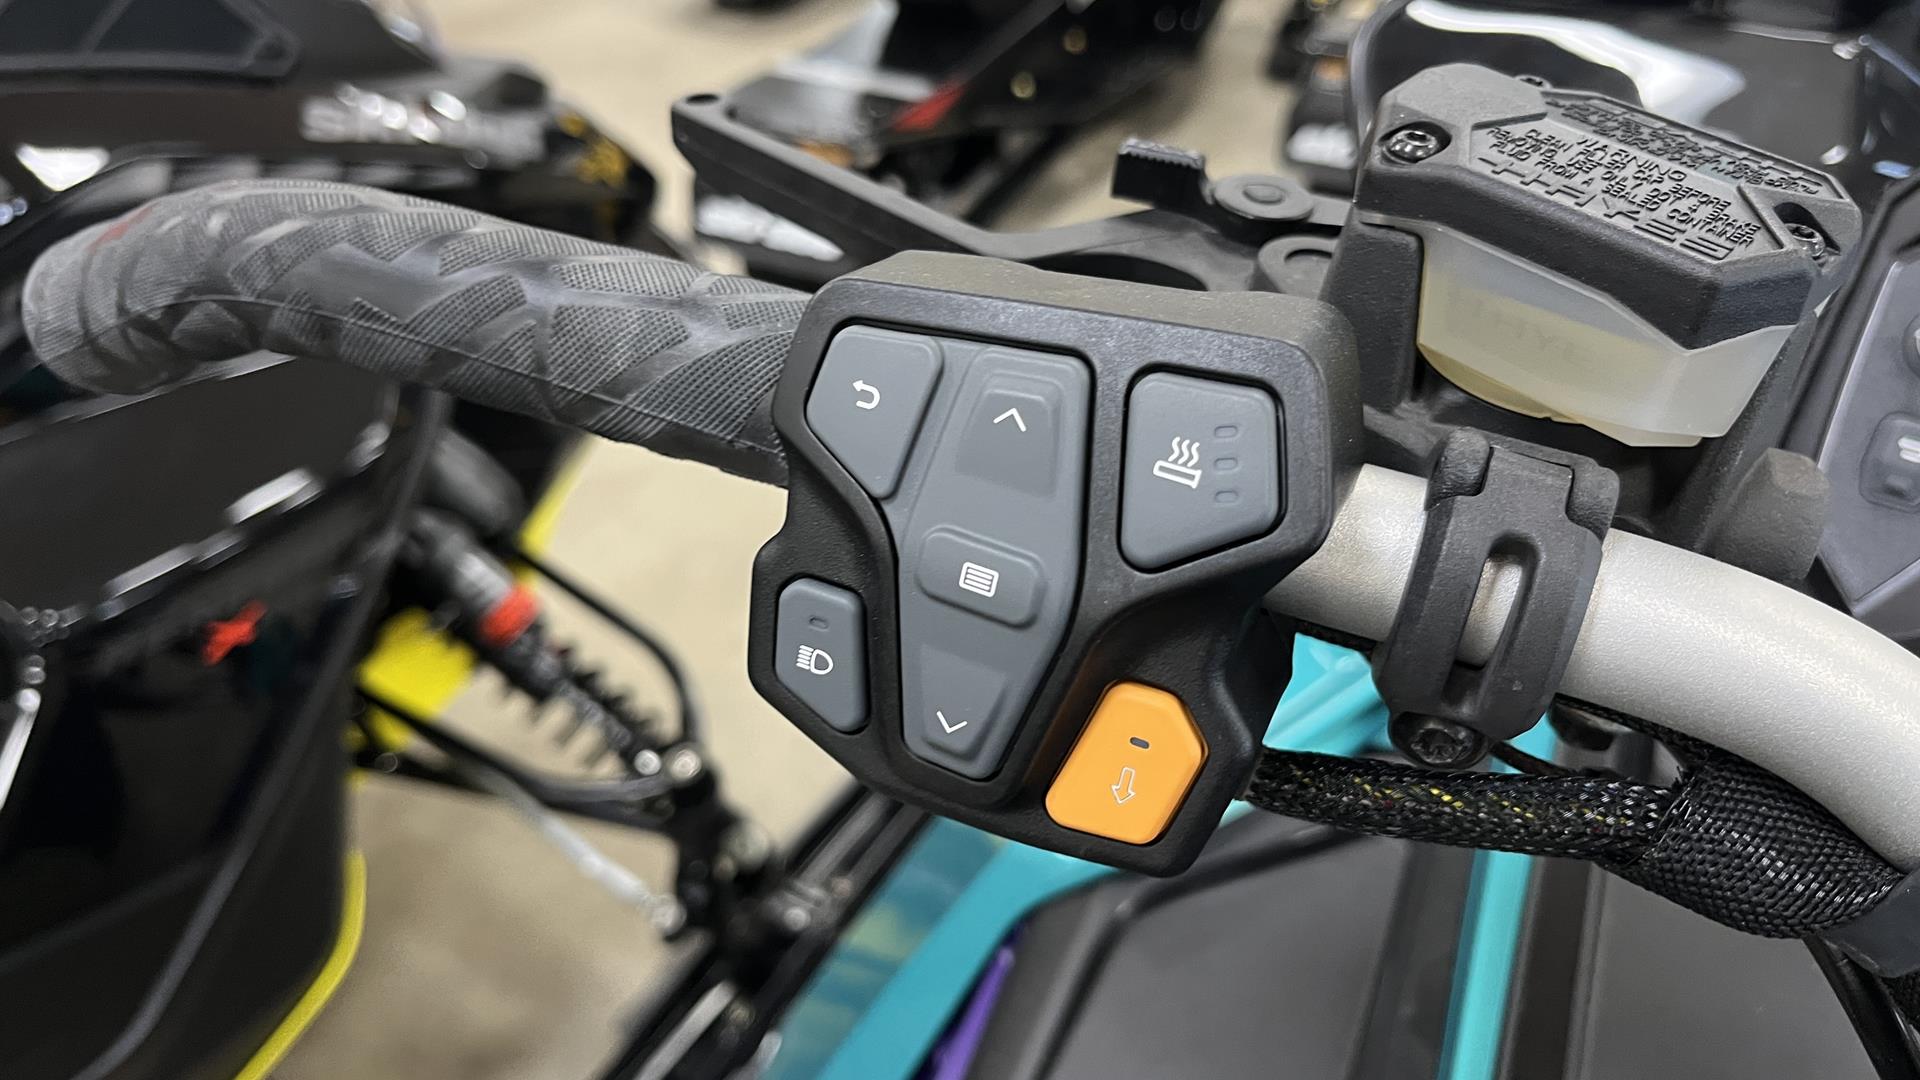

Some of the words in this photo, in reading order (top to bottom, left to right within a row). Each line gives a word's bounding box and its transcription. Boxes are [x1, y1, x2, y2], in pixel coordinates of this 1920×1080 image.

[1489, 140, 1531, 162] FLUID
[1534, 158, 1580, 180] FROM
[1581, 177, 1595, 187] A
[1601, 183, 1662, 212] SEALED
[1667, 208, 1754, 248] CONTAINER
[1524, 128, 1574, 153] CLEAN
[1632, 169, 1665, 186] CAP
[1669, 183, 1731, 211] BEFORE
[1566, 156, 1598, 174] USE
[1601, 170, 1644, 191] ONLY
[1650, 187, 1684, 206] DOT
[1707, 210, 1761, 236] BRAKE
[1576, 138, 1687, 182] WARNING
